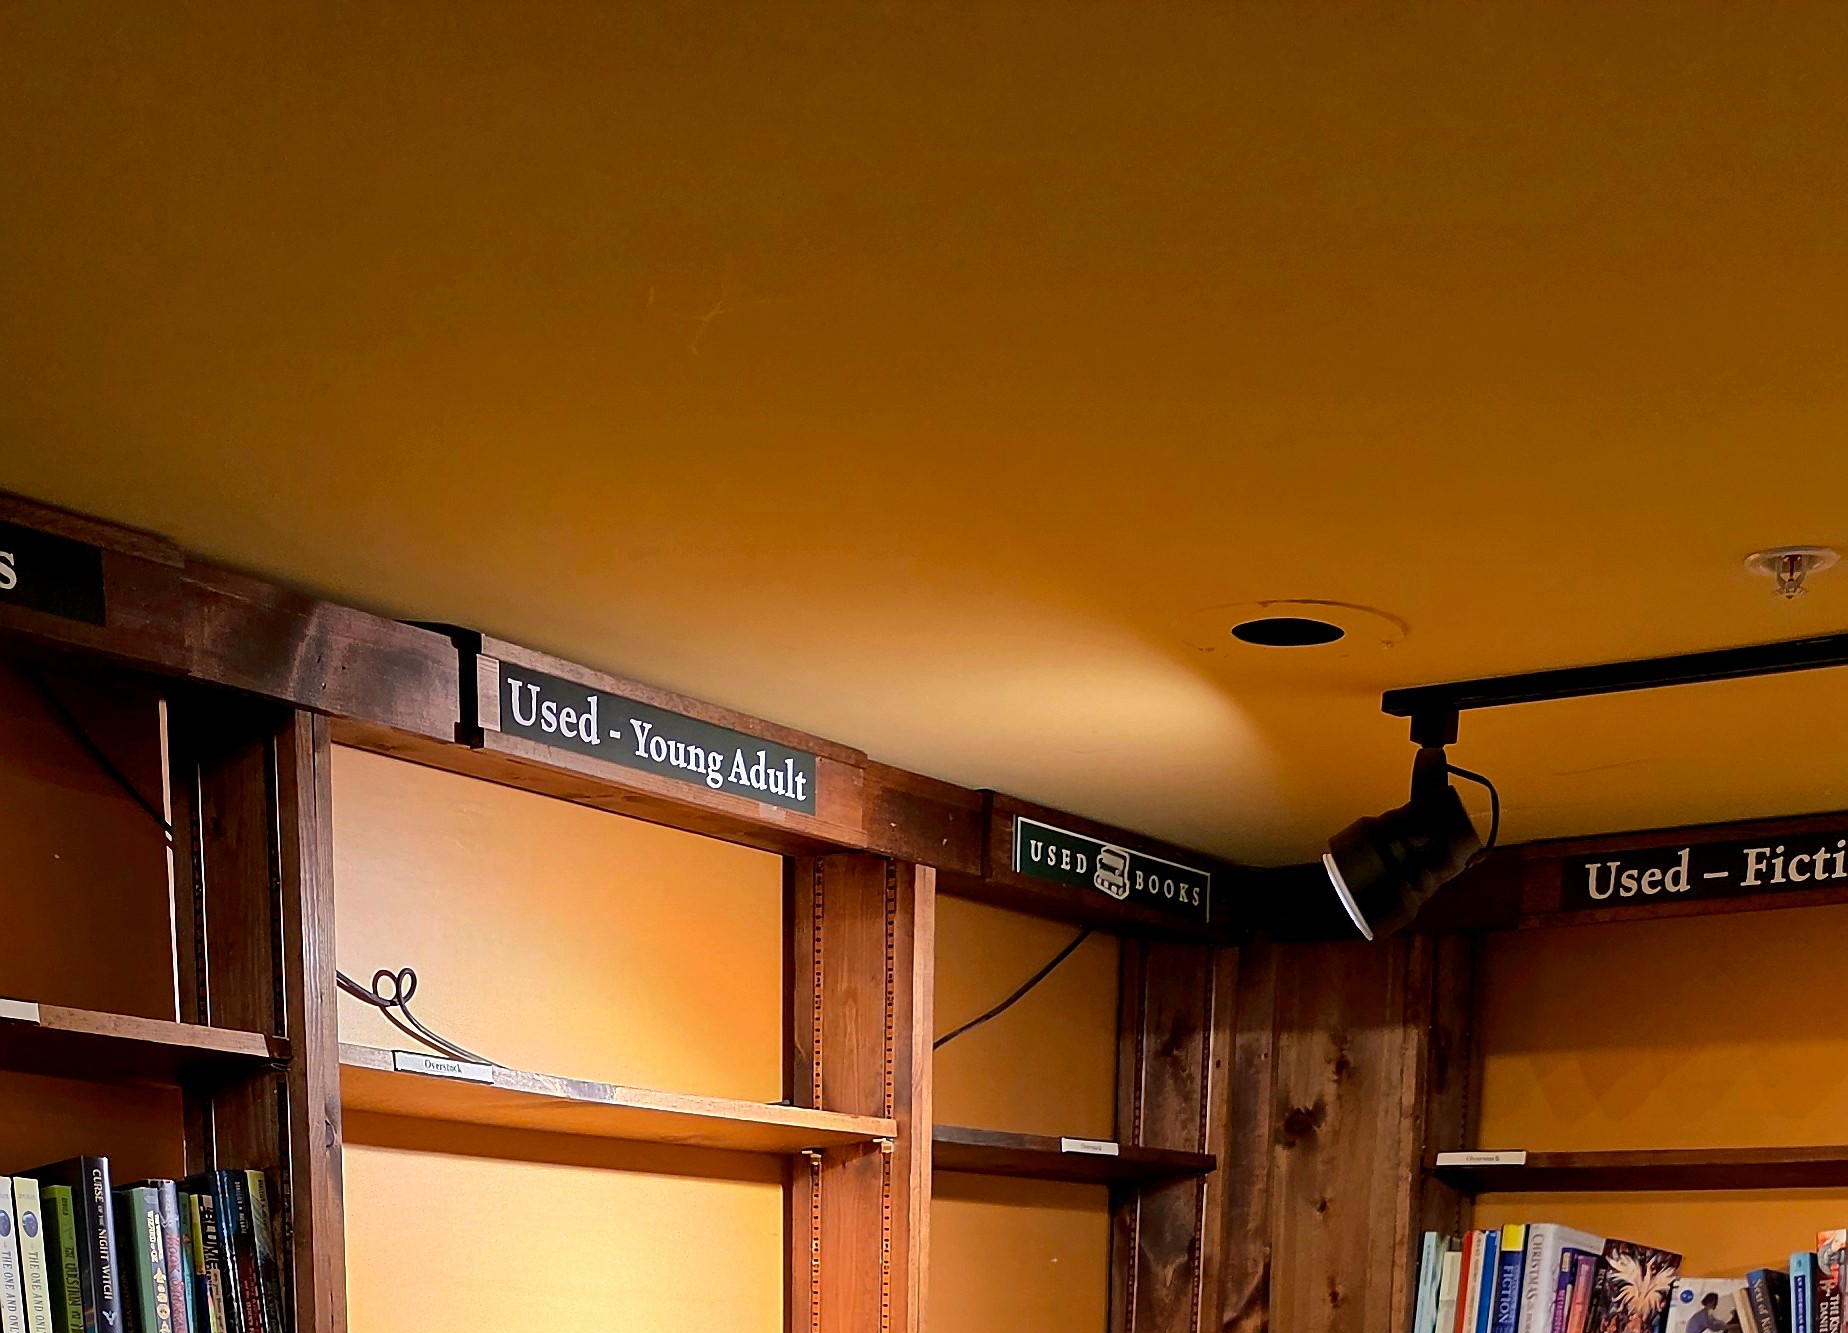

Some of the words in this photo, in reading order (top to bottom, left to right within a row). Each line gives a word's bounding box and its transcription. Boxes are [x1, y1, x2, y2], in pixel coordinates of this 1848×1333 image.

[507, 677, 600, 746] Used
[630, 718, 724, 789] Young
[728, 748, 807, 802] Adult
[1030, 840, 1087, 874] USED
[1135, 871, 1200, 906] BOOKS
[1585, 848, 1691, 900] Used
[1740, 839, 1848, 887] Ficti
[92, 1168, 104, 1203] CURSE
[98, 1228, 111, 1266] NIGHT
[1526, 1233, 1545, 1301] CHRISTMAS
[101, 1266, 113, 1300] WITCH
[1499, 1266, 1515, 1323] FICTION
[1829, 1294, 1840, 1316] THE
